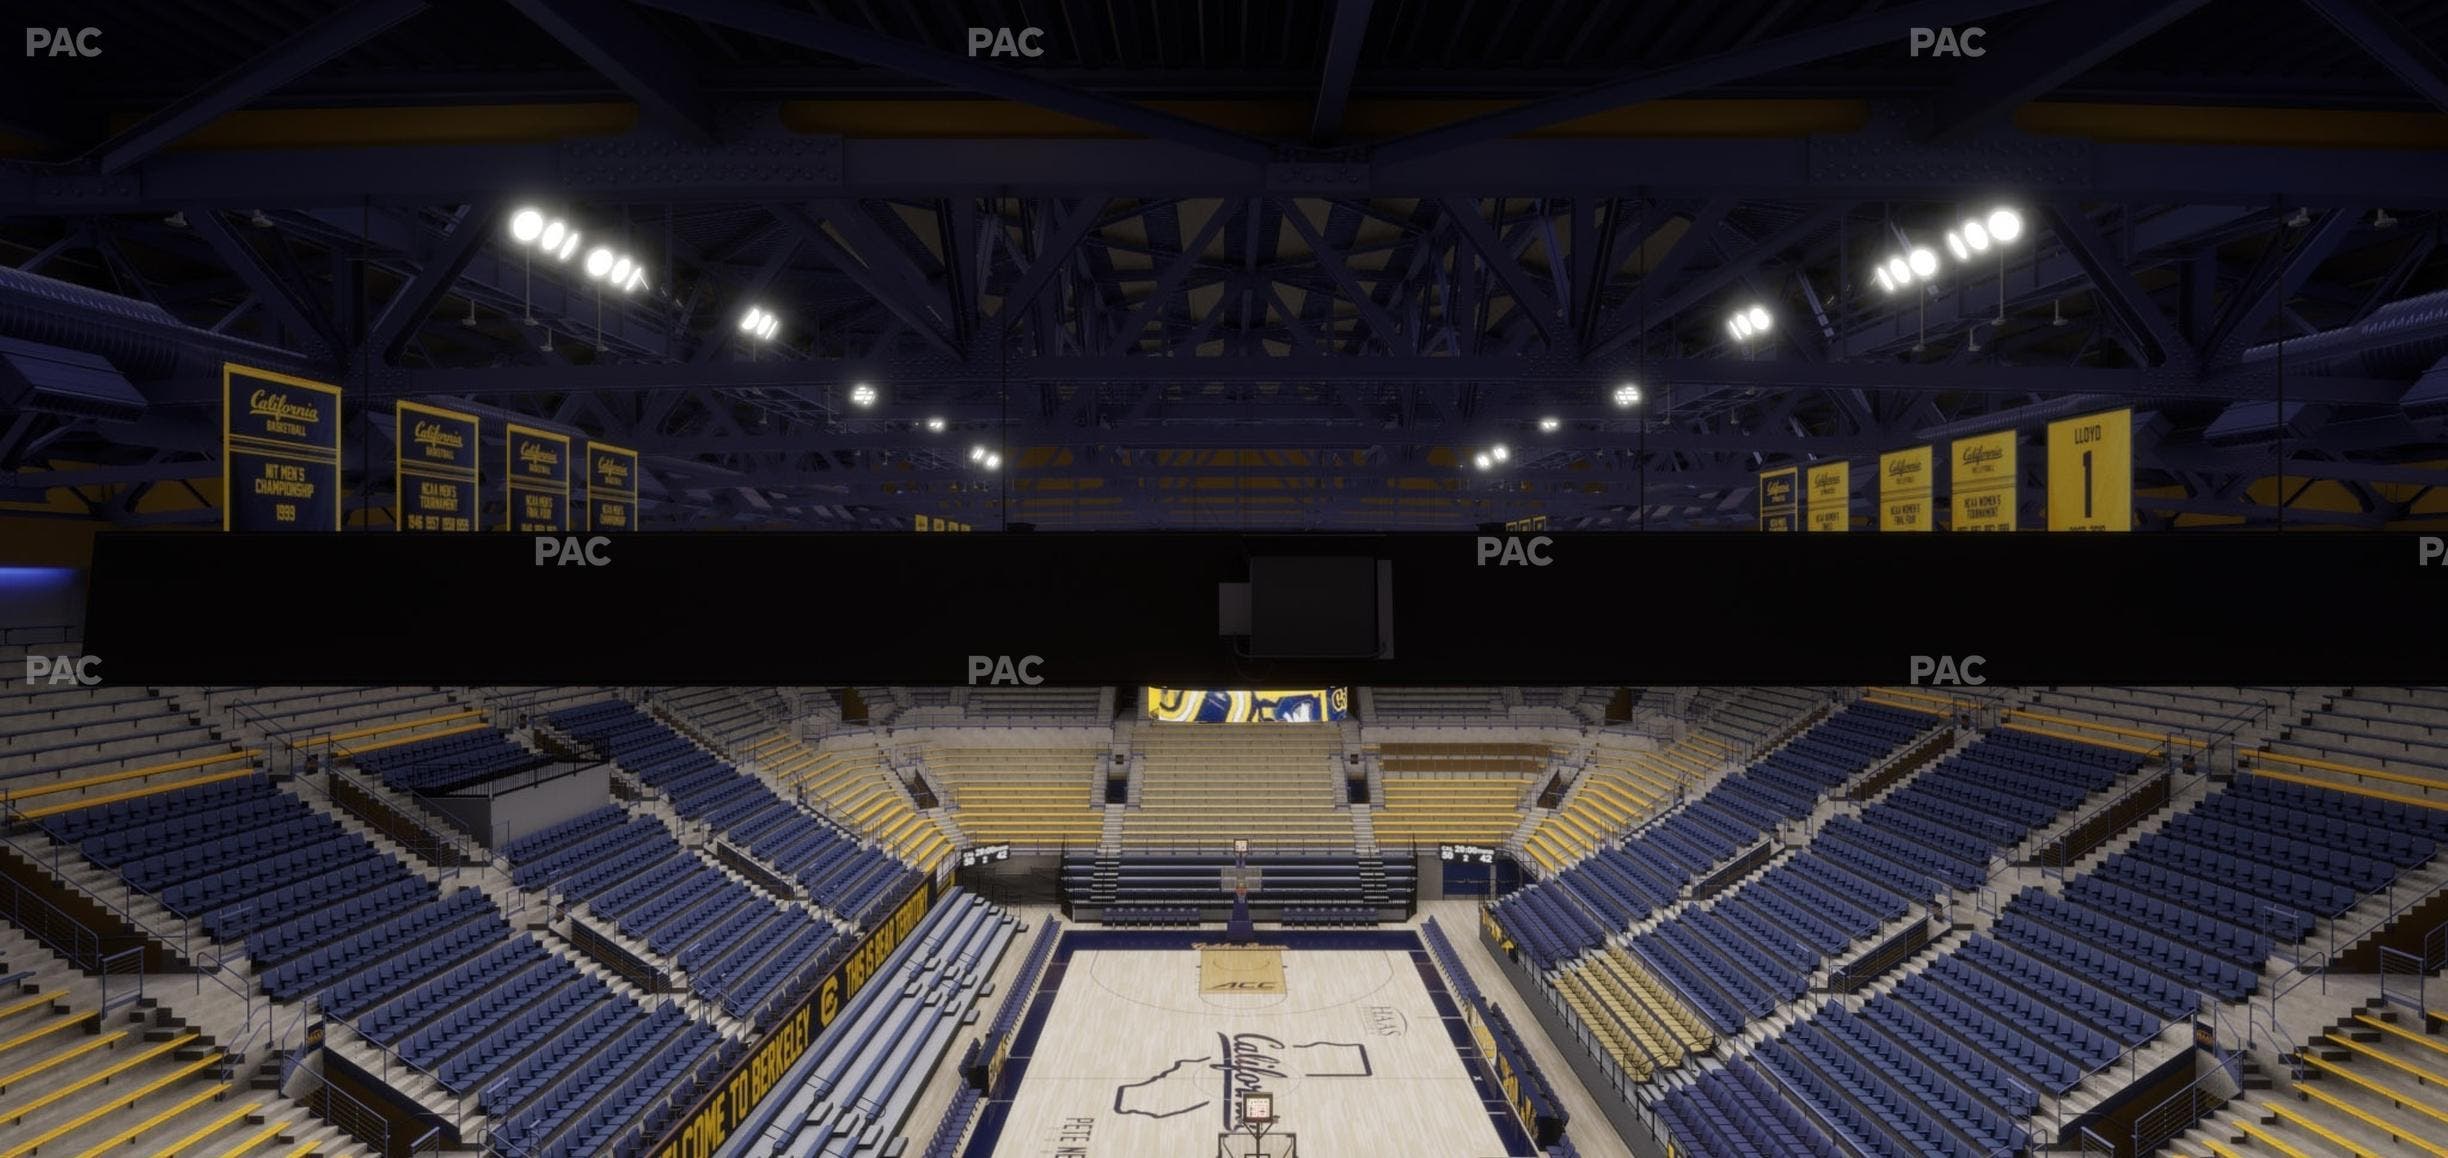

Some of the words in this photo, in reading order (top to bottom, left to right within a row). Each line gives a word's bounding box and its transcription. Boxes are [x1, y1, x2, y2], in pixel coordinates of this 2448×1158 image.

[250, 389, 318, 422] California
[266, 420, 306, 436] BASKETBALL
[414, 420, 463, 448] California
[2074, 424, 2102, 445] LLOYD
[520, 440, 558, 464] California
[1962, 445, 2003, 465] California
[265, 463, 280, 479] NIT
[280, 465, 305, 482] MEN'S
[1888, 458, 1923, 477] California
[255, 478, 314, 499] CHAMPIONSHIP
[2083, 450, 2093, 518] 1
[1479, 854, 1493, 863] 42
[846, 949, 865, 1001] THIS
[866, 939, 875, 980] IS
[875, 918, 895, 970] BEAR
[895, 882, 928, 948] TERRITORY
[1211, 981, 1278, 991] ACC
[1370, 1006, 1402, 1037] HAAS
[730, 1069, 749, 1129] TO
[752, 1003, 810, 1107] BERKELEY
[1059, 1118, 1095, 1142] PETE
